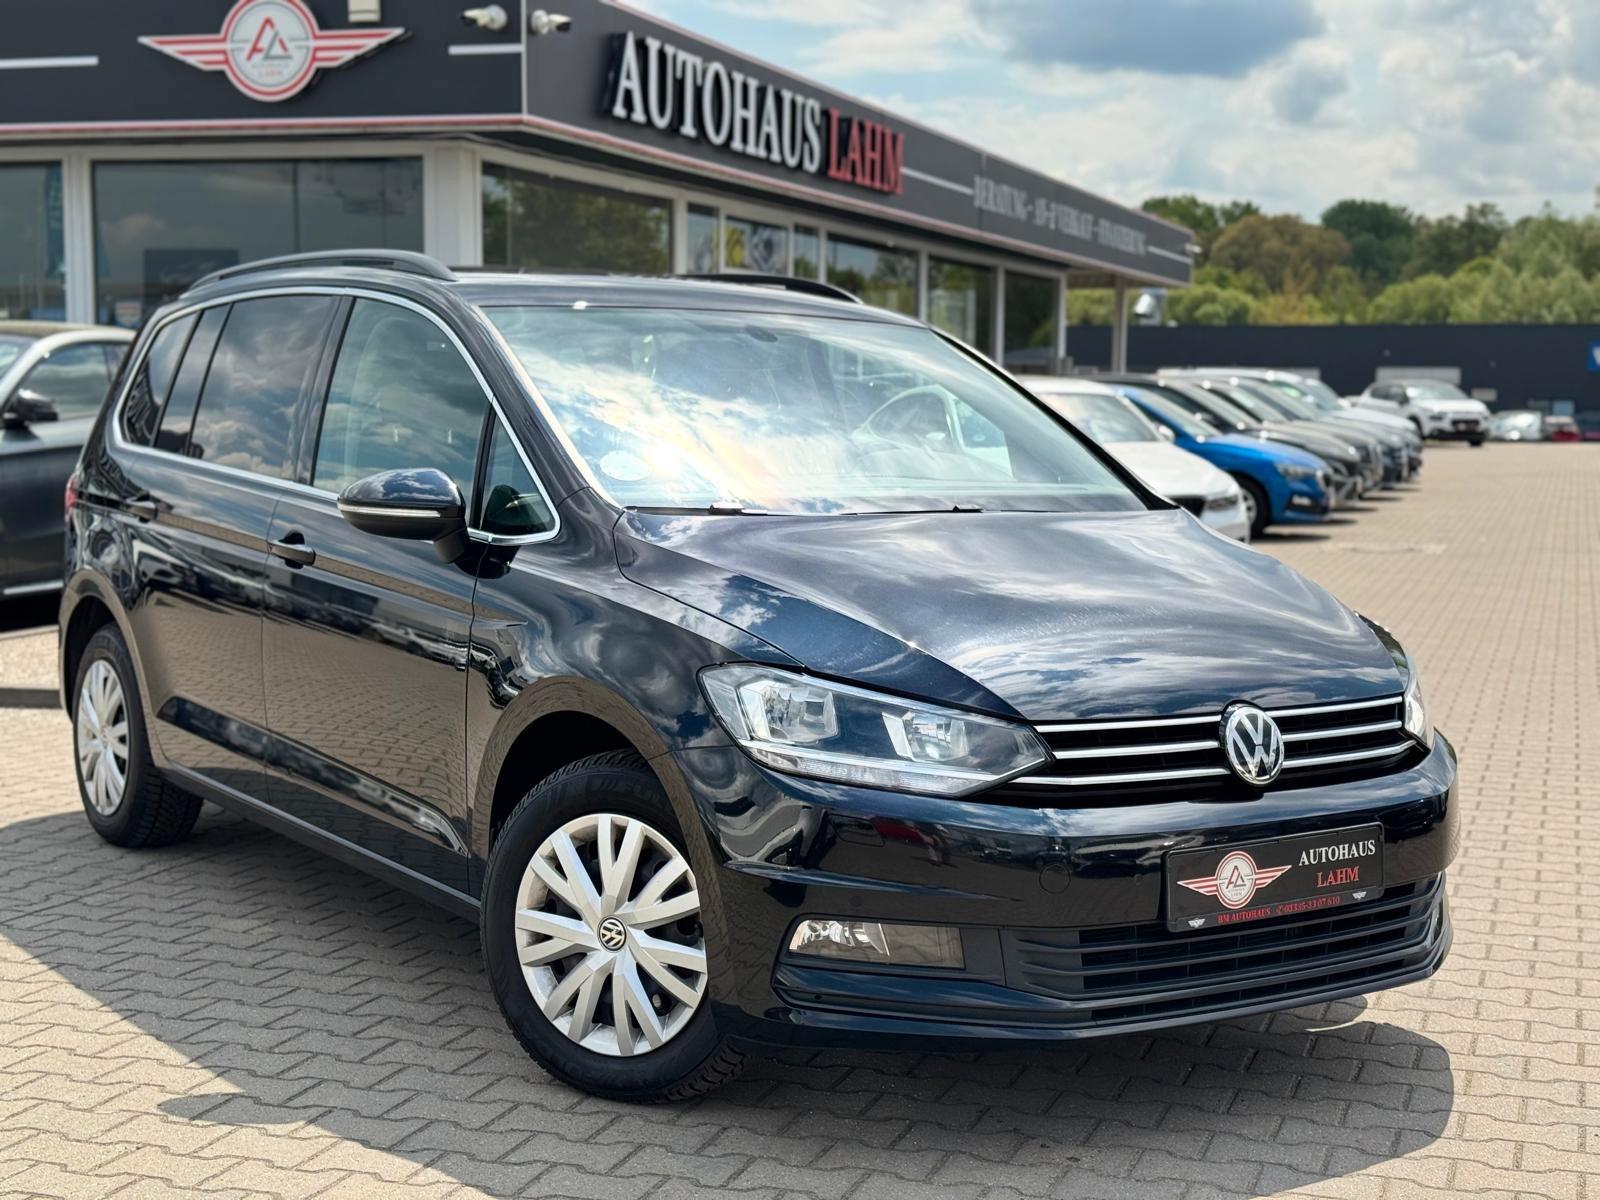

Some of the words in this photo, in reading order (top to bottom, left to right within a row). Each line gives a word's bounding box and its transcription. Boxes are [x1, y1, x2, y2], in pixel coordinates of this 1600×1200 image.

[612, 31, 821, 173] AUTOHAUS
[826, 107, 904, 194] LAHM
[1299, 840, 1376, 866] AUTOHAUS
[1316, 866, 1360, 888] LAHM
[1231, 908, 1272, 922] AUTOHAUS
